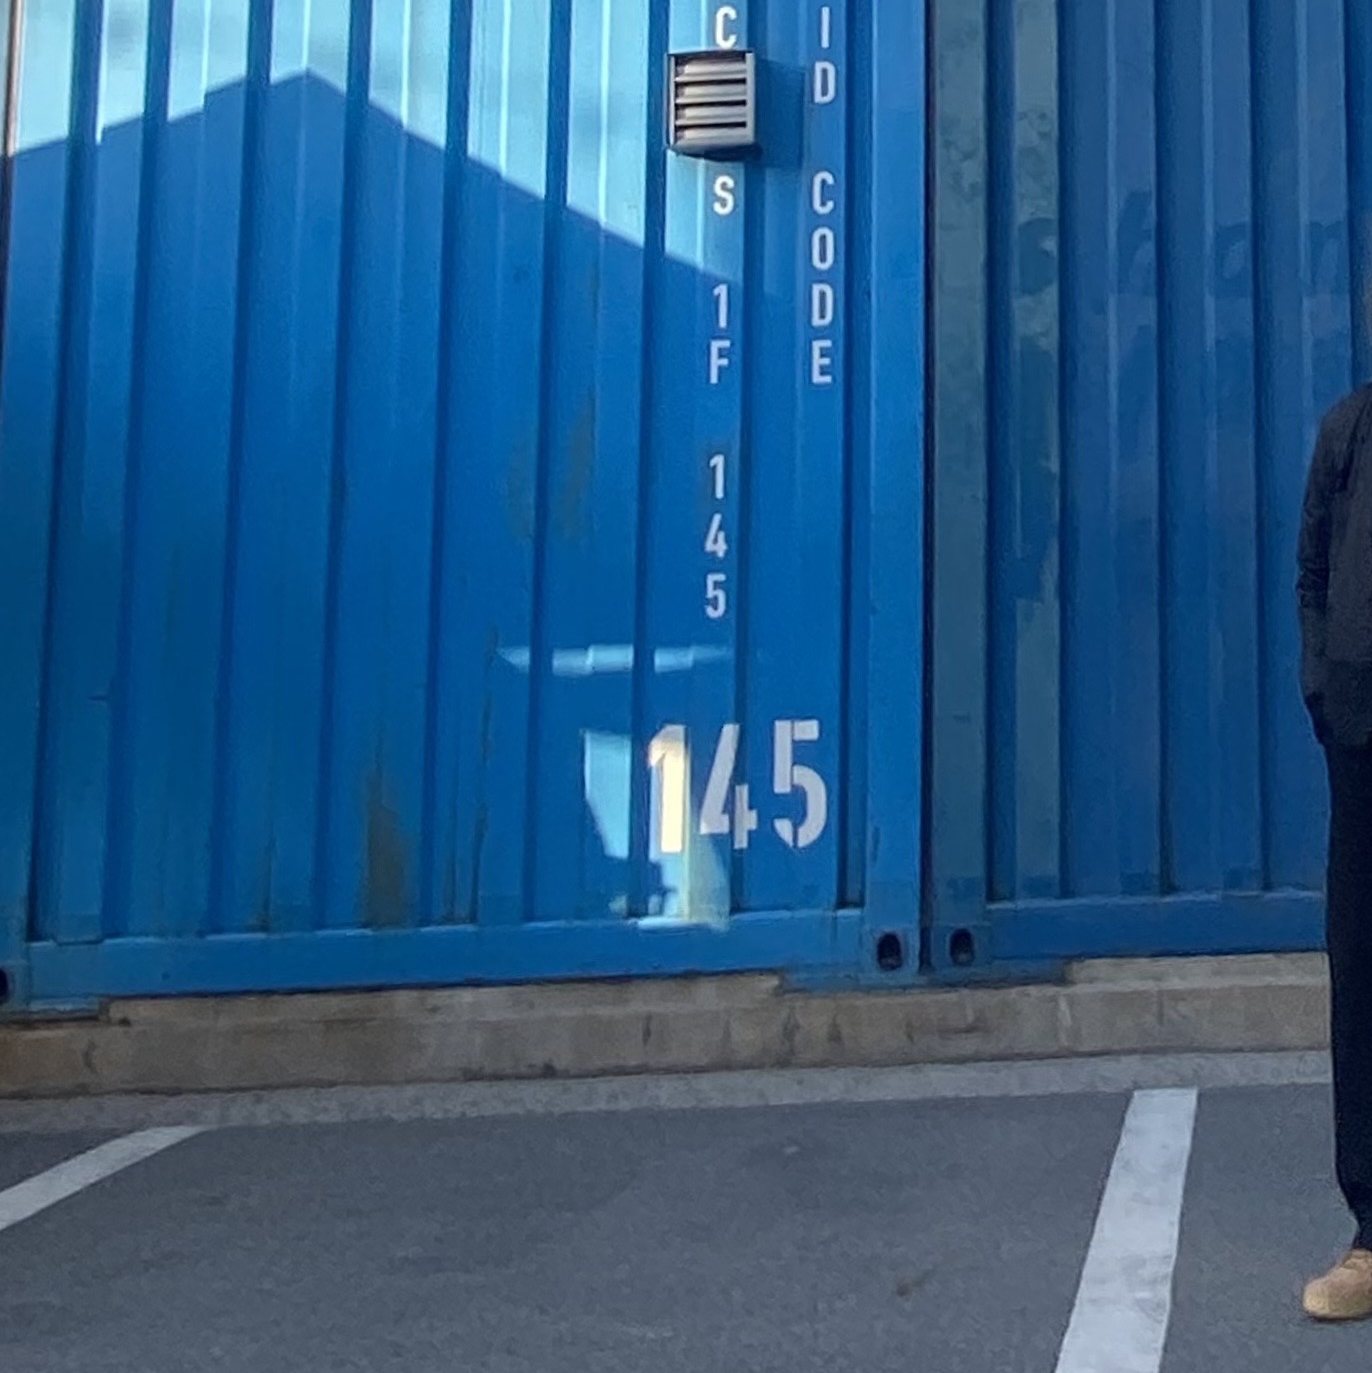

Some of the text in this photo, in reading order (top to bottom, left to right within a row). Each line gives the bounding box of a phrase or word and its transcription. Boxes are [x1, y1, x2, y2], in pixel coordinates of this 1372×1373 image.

[704, 6, 737, 618] CS 1F 145
[811, 7, 835, 384] ID CODE
[646, 719, 828, 853] 145
